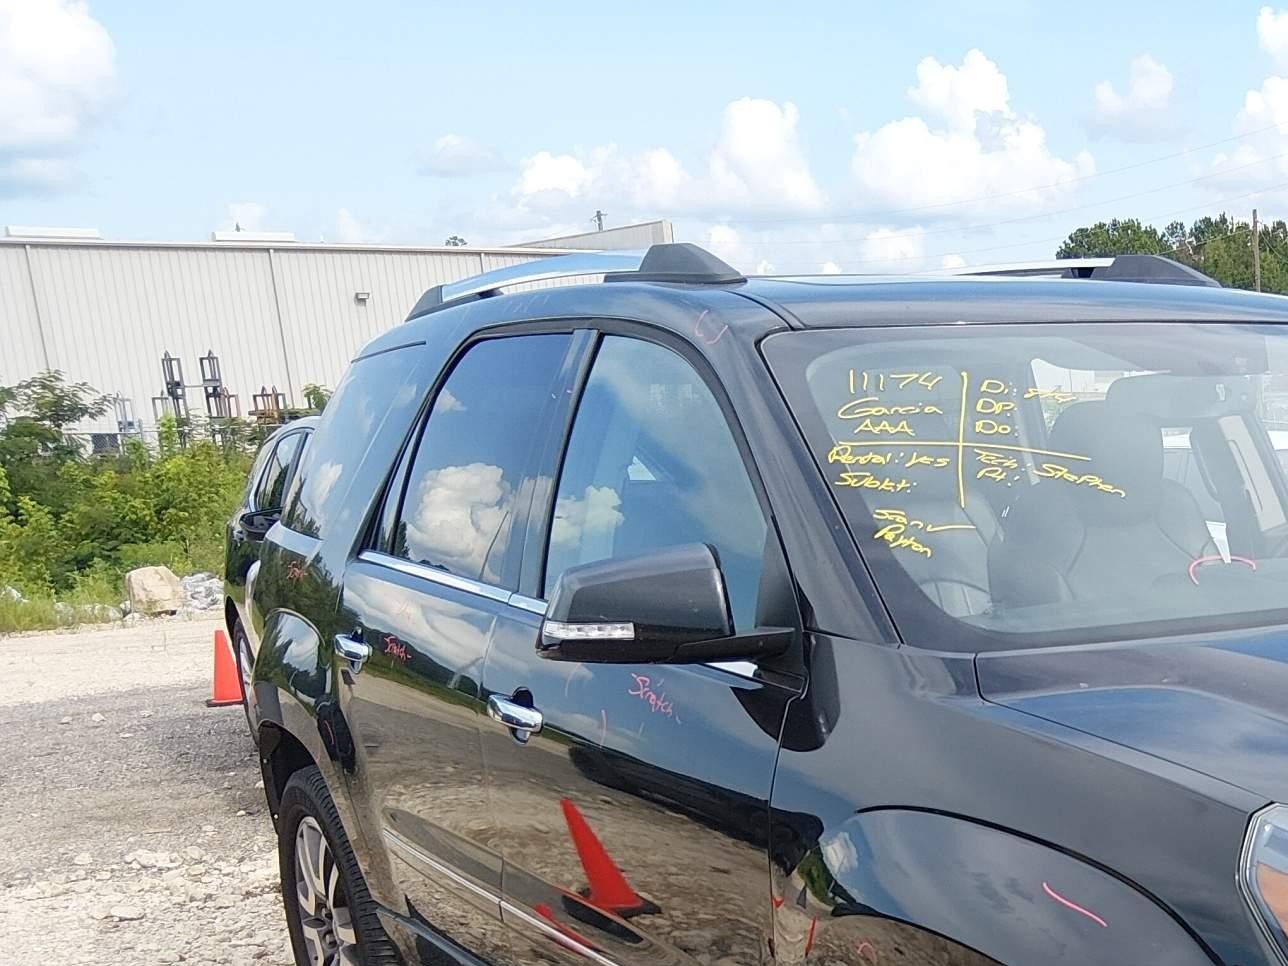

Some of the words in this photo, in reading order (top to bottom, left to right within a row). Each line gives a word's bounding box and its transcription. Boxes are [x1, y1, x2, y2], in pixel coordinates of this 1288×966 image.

[849, 369, 943, 394] 11174
[838, 397, 944, 419] Garcia
[854, 418, 916, 436] AAA
